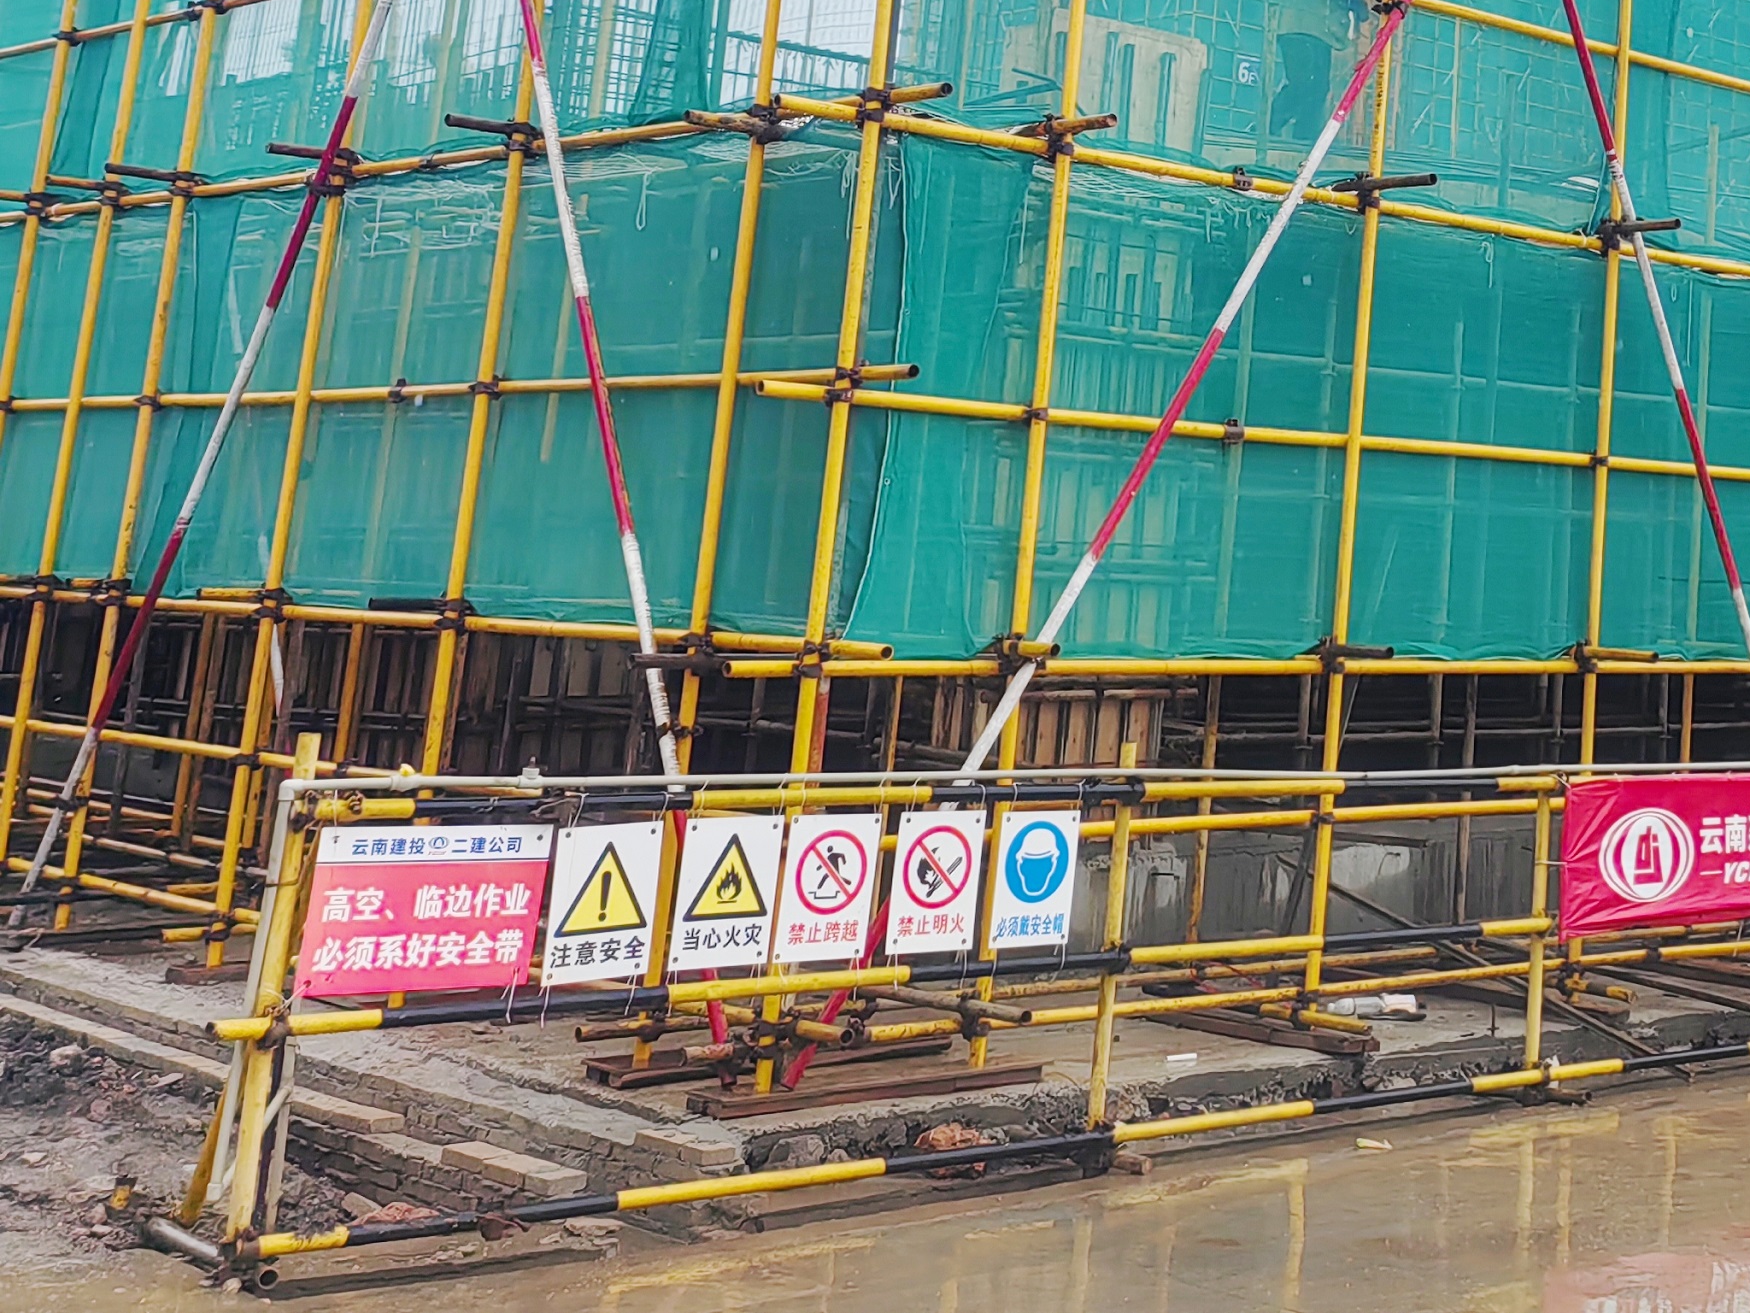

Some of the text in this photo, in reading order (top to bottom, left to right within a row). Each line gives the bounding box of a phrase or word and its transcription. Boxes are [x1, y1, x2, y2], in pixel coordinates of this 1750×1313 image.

[351, 836, 523, 856] 云南建投 二建公司
[682, 922, 763, 952] 当心火灾
[787, 919, 860, 945] 禁止跨越
[896, 912, 965, 938] 禁止明火
[995, 912, 1065, 939] 必须戴安全帽
[312, 928, 525, 972] 必须系好安全带
[549, 935, 646, 970] 注意安全
